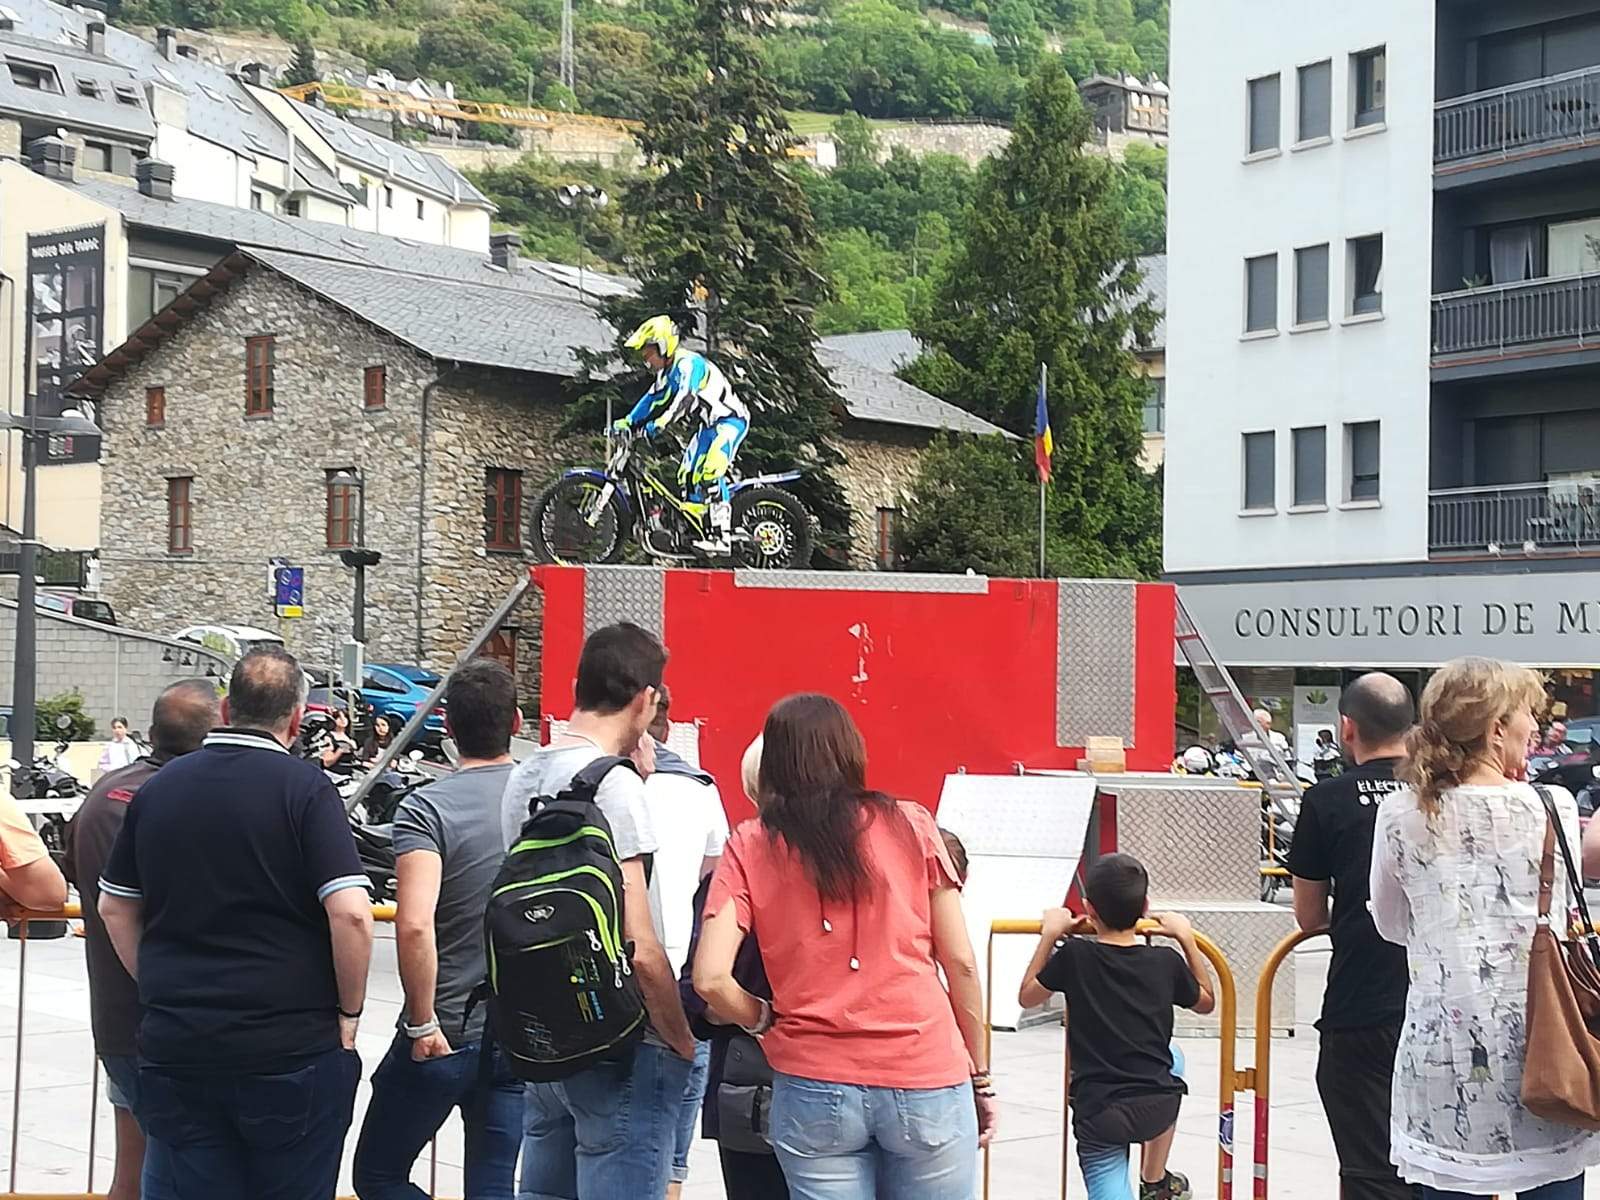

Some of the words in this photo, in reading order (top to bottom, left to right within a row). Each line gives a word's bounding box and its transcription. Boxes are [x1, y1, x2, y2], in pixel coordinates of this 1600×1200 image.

[1235, 604, 1463, 638] CONSULTORI
[1482, 602, 1534, 635] DE
[1556, 601, 1600, 635] M
